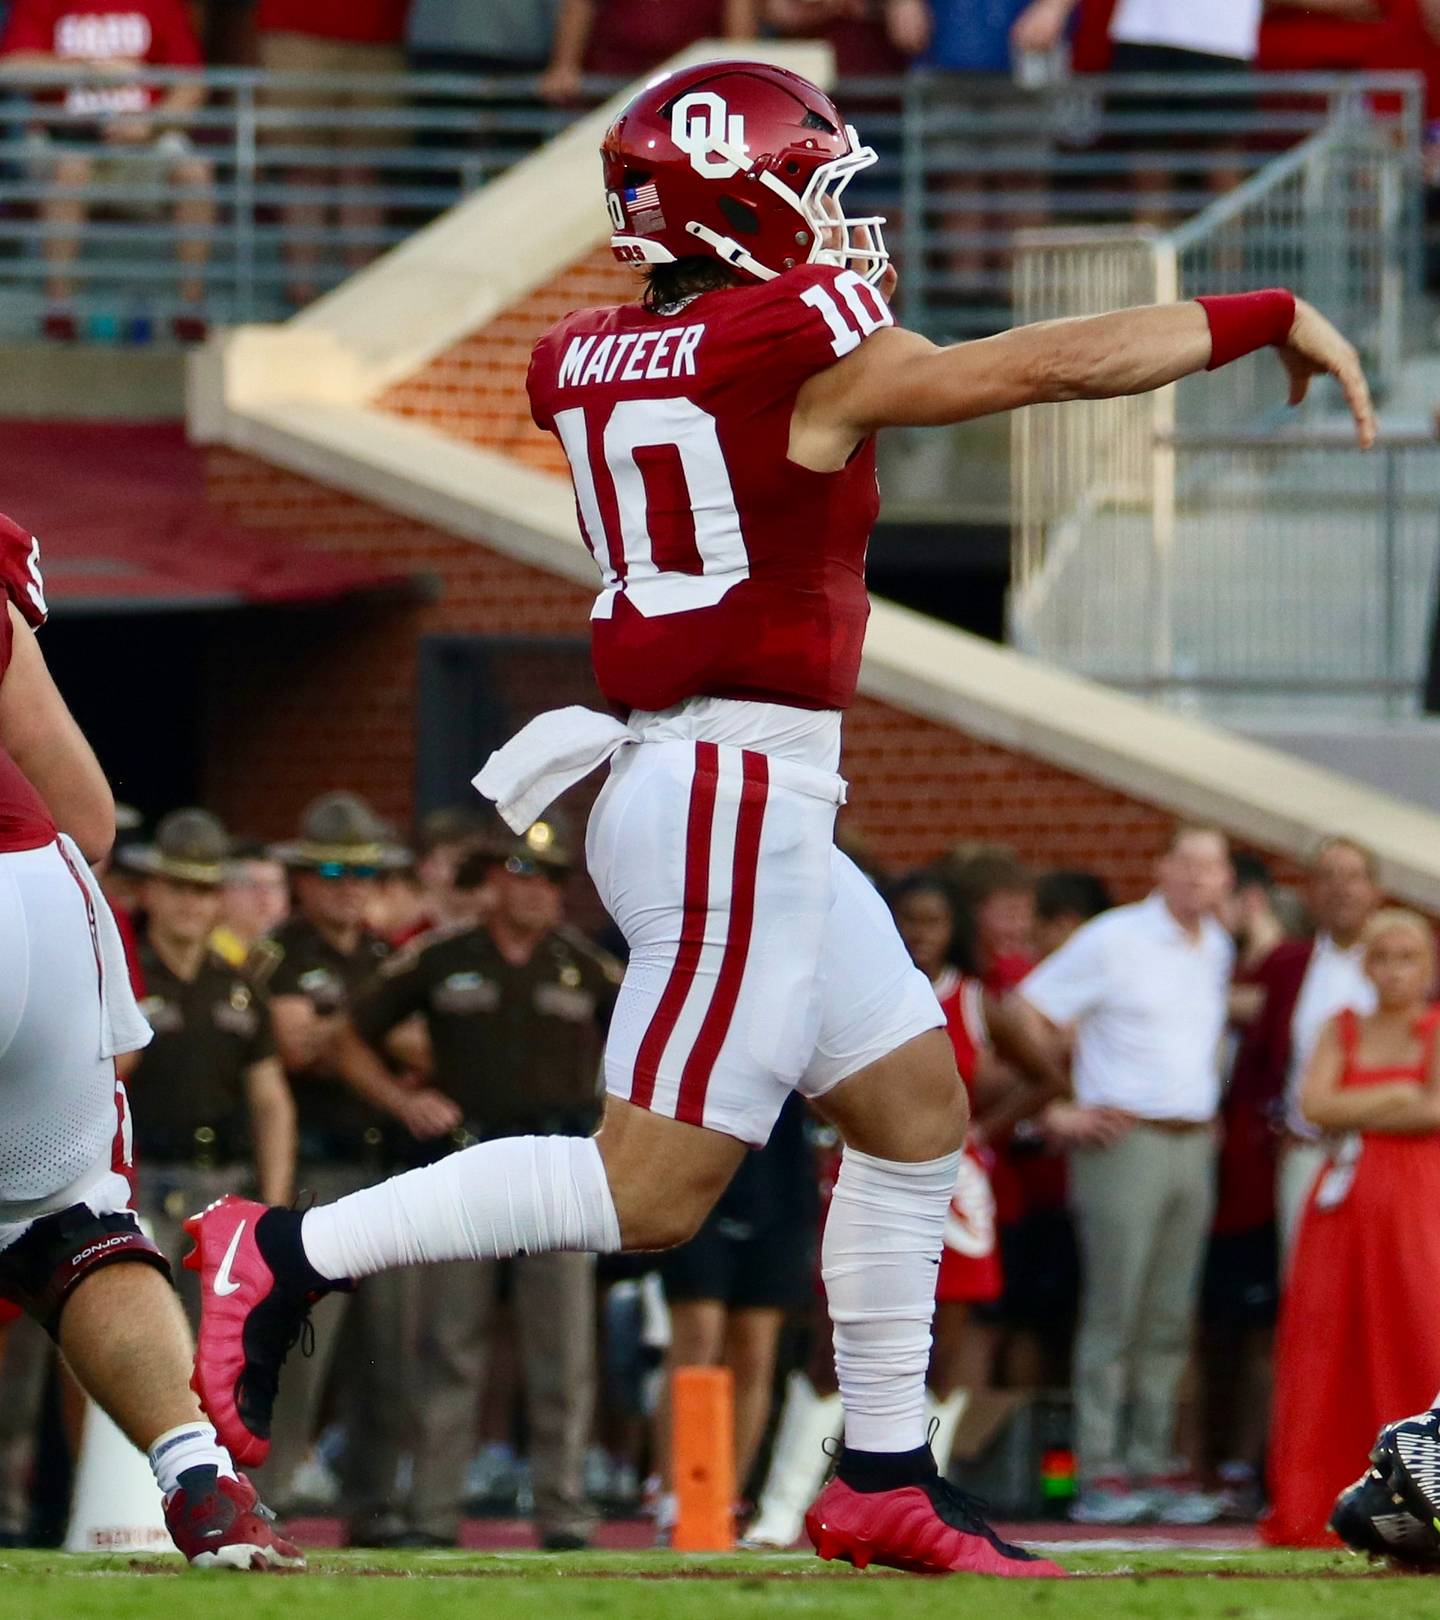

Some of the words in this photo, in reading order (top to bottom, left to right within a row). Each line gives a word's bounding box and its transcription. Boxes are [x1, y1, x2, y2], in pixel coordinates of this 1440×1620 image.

[671, 91, 749, 180] OU
[557, 322, 706, 390] MATEER
[800, 268, 895, 358] 10
[552, 396, 751, 620] 10
[72, 1235, 134, 1266] DONJOY
